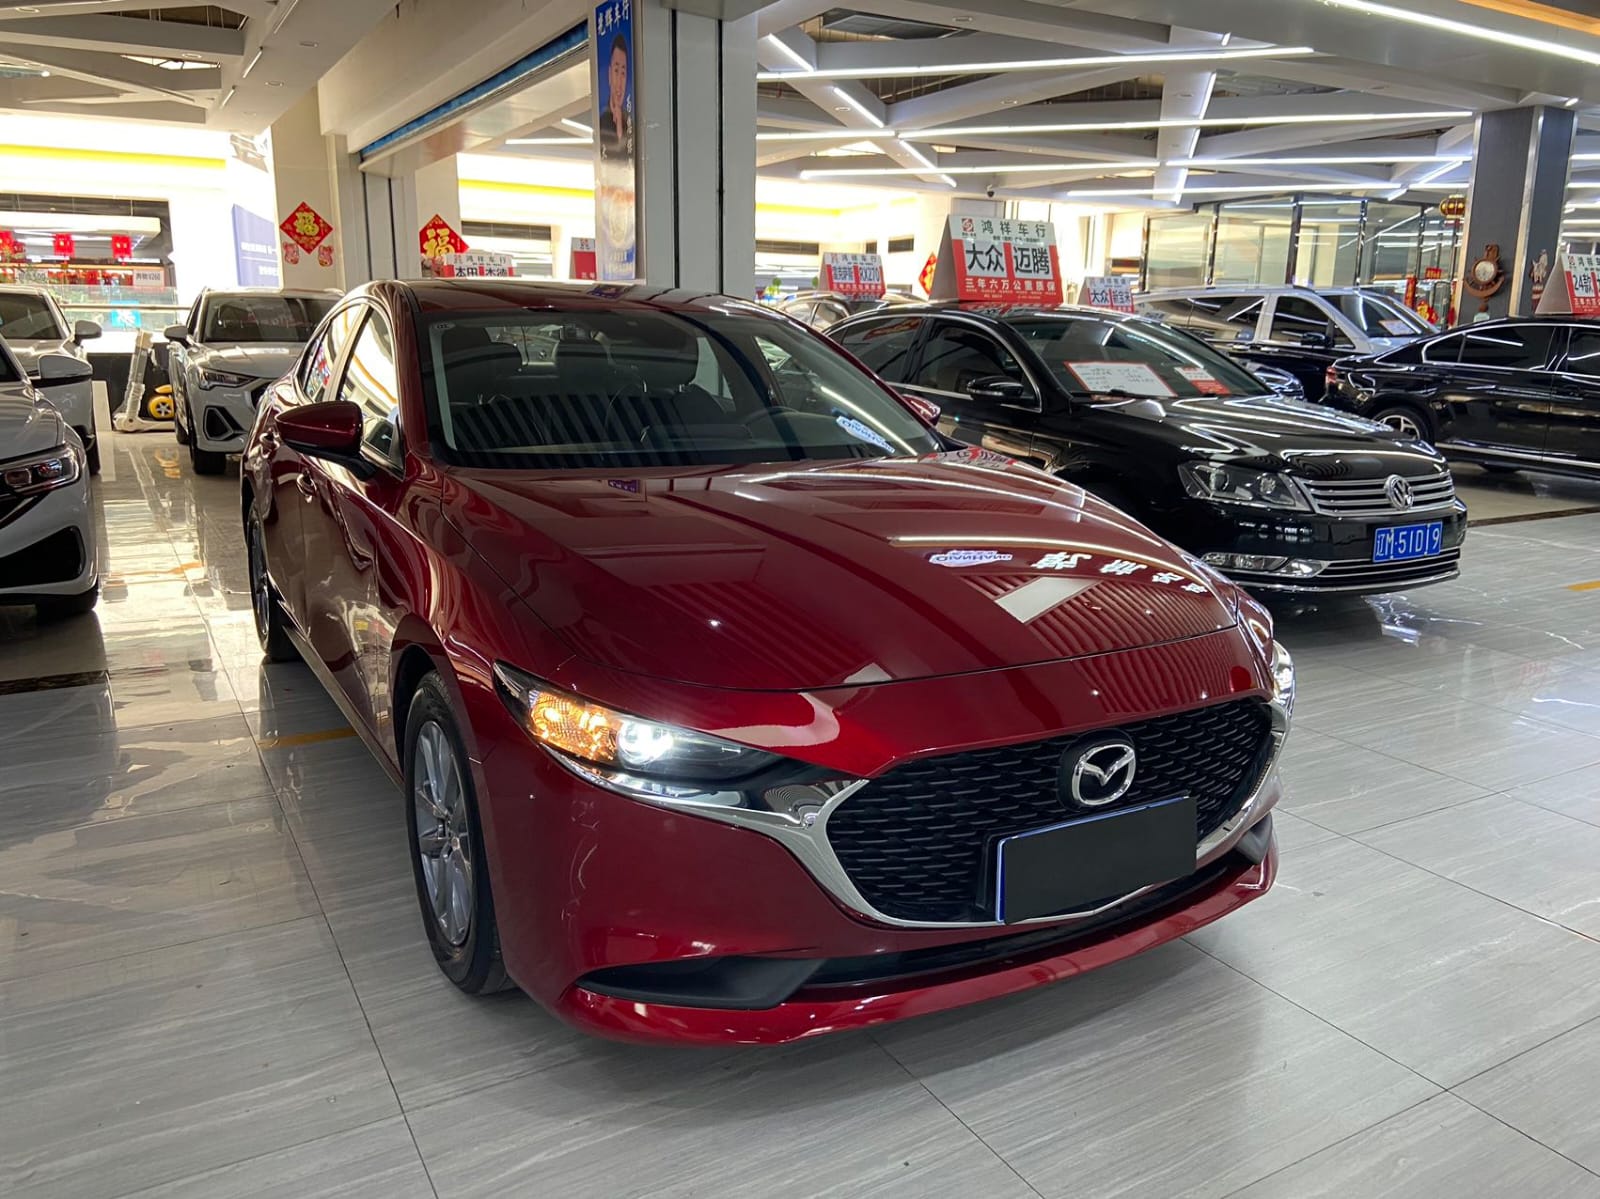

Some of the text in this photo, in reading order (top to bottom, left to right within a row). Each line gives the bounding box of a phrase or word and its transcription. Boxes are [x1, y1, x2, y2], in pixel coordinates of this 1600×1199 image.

[293, 211, 320, 236] 福
[981, 219, 1047, 238] 鸿祥车行
[423, 228, 455, 258] 福
[965, 243, 1005, 273] 大众
[1013, 247, 1051, 275] 迈腾
[1090, 289, 1110, 304] 大众
